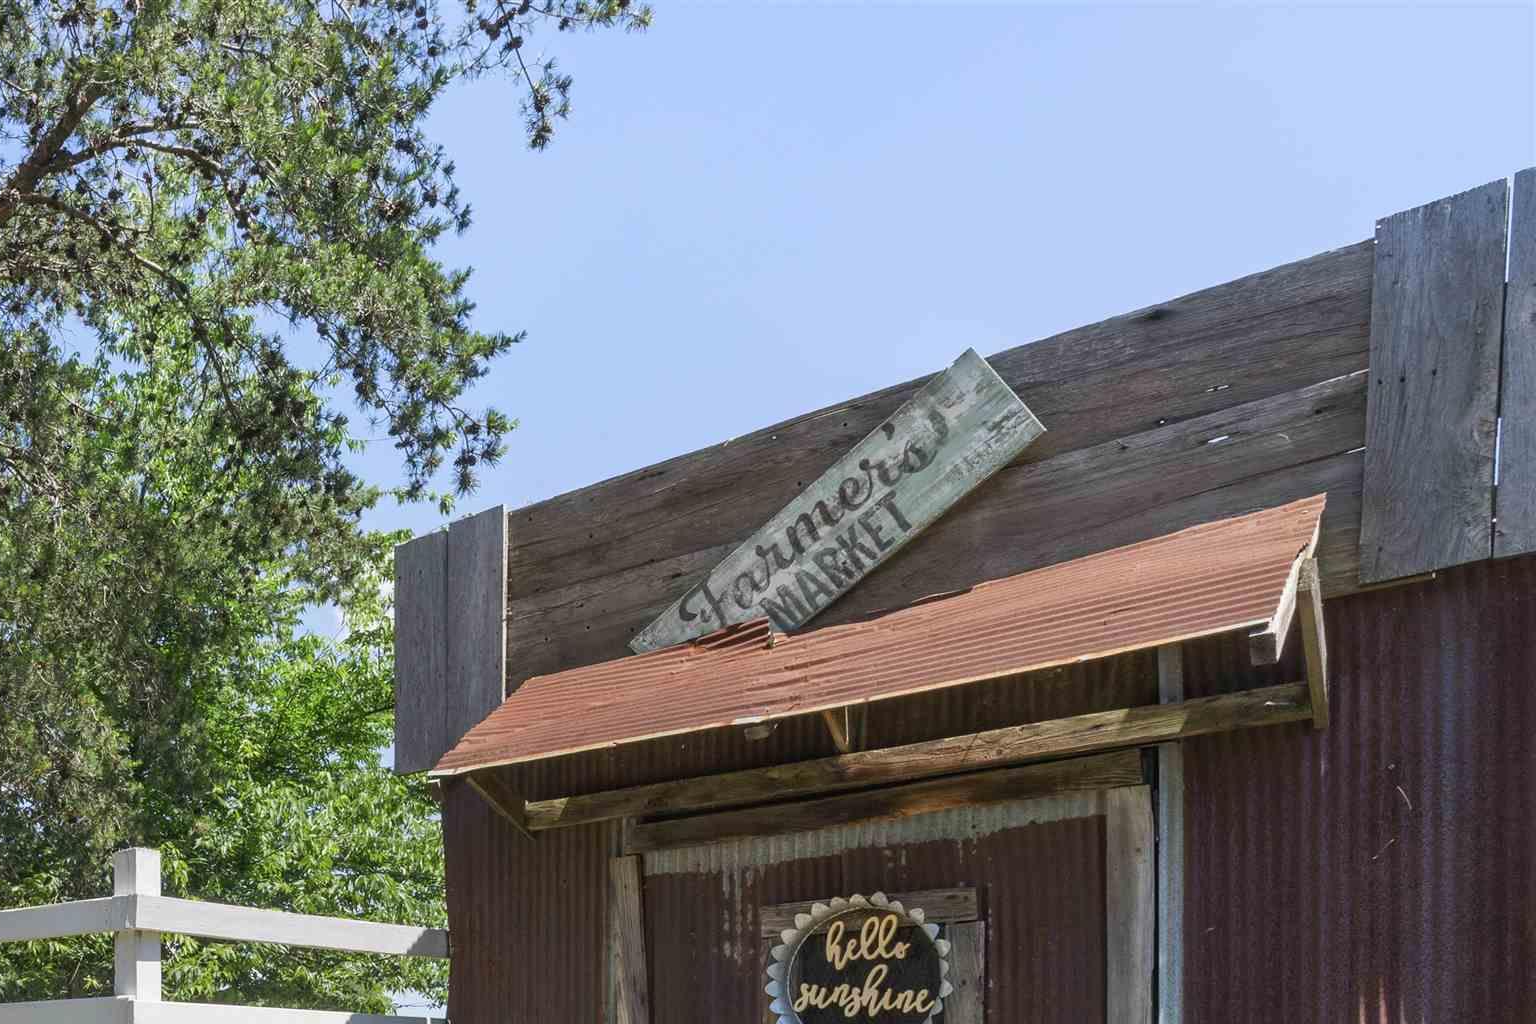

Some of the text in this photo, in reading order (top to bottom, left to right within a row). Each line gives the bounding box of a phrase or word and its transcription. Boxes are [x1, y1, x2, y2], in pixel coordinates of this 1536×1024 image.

[762, 491, 914, 630] MARKET
[826, 914, 912, 971] hello
[792, 964, 936, 1018] sunshine
